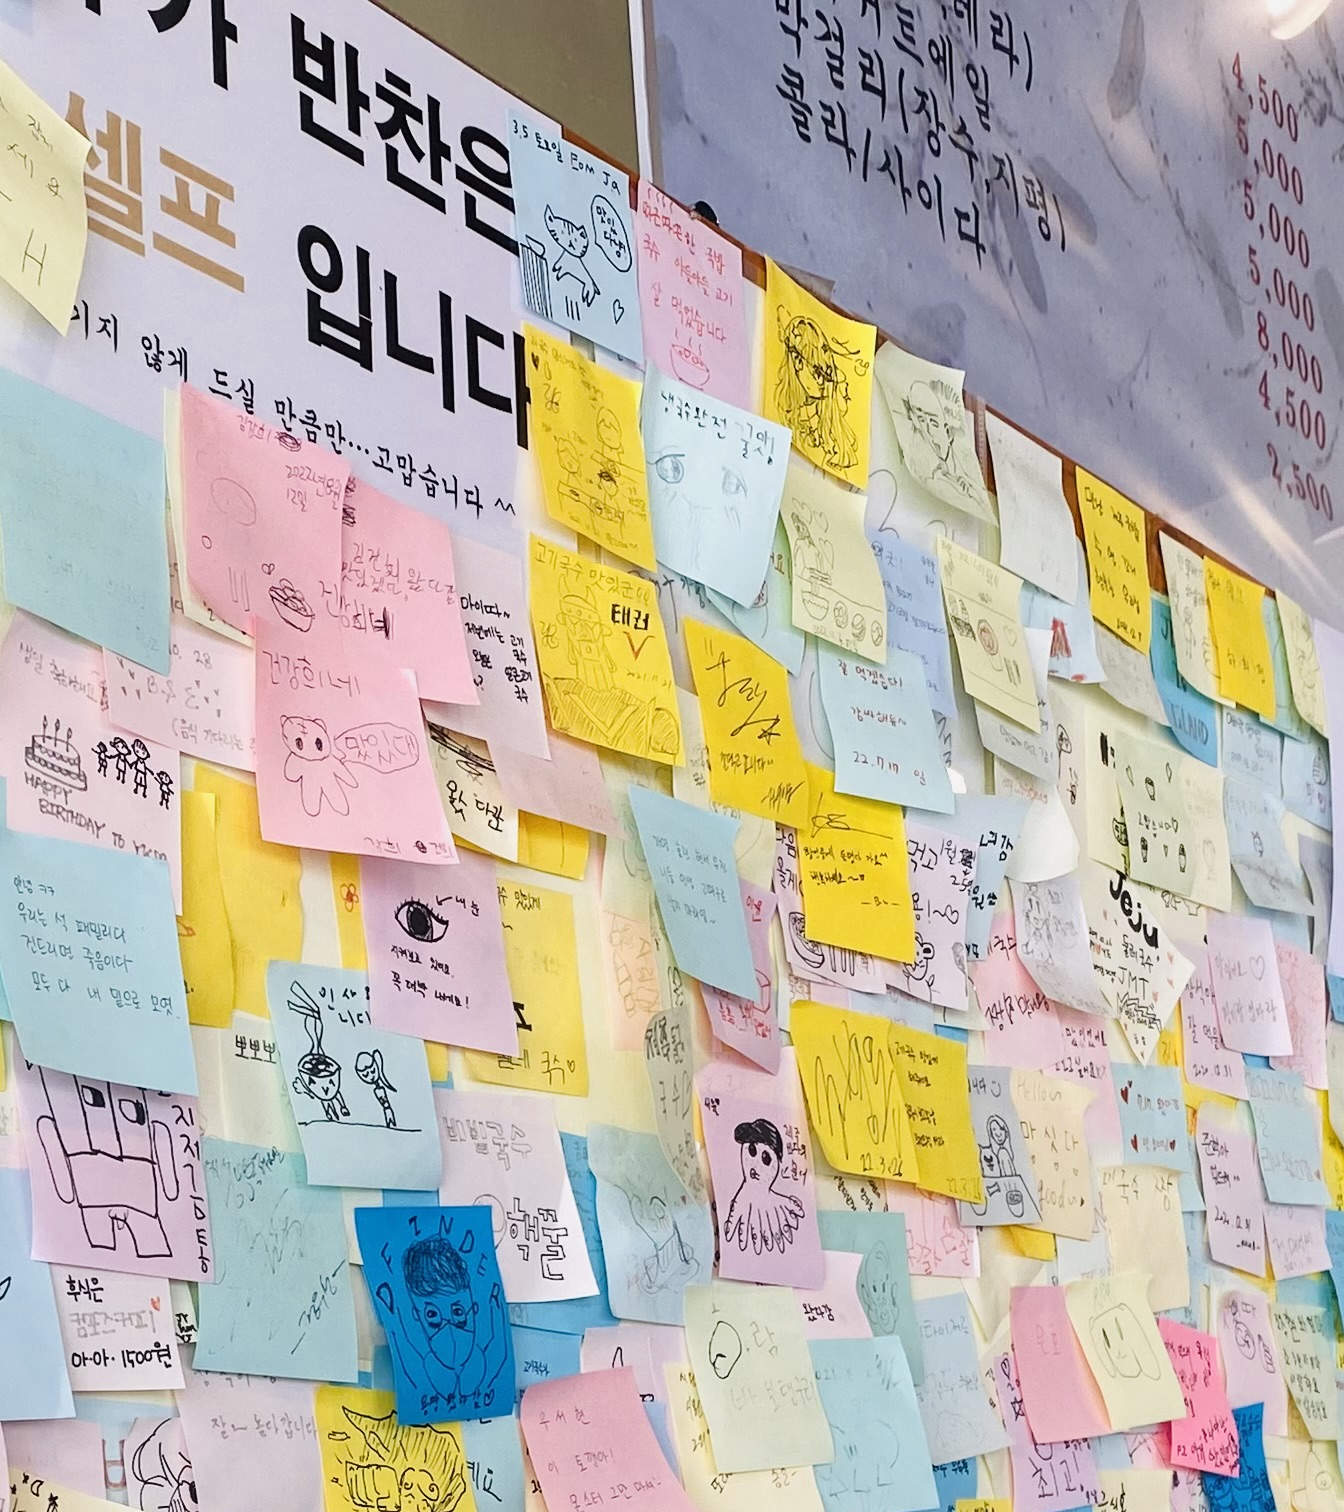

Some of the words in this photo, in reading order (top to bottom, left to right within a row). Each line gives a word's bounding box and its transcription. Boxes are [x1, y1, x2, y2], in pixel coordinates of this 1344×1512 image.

[289, 12, 520, 257] 반찬은
[1233, 52, 1298, 143] 4,500
[775, 63, 986, 270] 콜라/사이다
[1237, 118, 1303, 205] 5,000
[1244, 180, 1310, 270] 5,000
[68, 91, 245, 293] 셀프
[297, 225, 531, 451] 입니다
[1250, 244, 1314, 332] 5,000
[141, 335, 189, 382] 않게
[209, 369, 255, 415] 드실
[1257, 312, 1323, 393] 8,000
[1259, 369, 1326, 445] 4,500
[1268, 442, 1335, 520] 2,500
[24, 771, 73, 805] HAPPY
[38, 798, 107, 840] BIRTHDAY
[17, 902, 47, 926] 우리는
[1110, 870, 1159, 949] Jeju
[21, 934, 74, 961] 건드리면
[83, 947, 133, 973] 죽음이다
[1119, 967, 1149, 1001] JMT
[66, 1275, 104, 1303] 후식은
